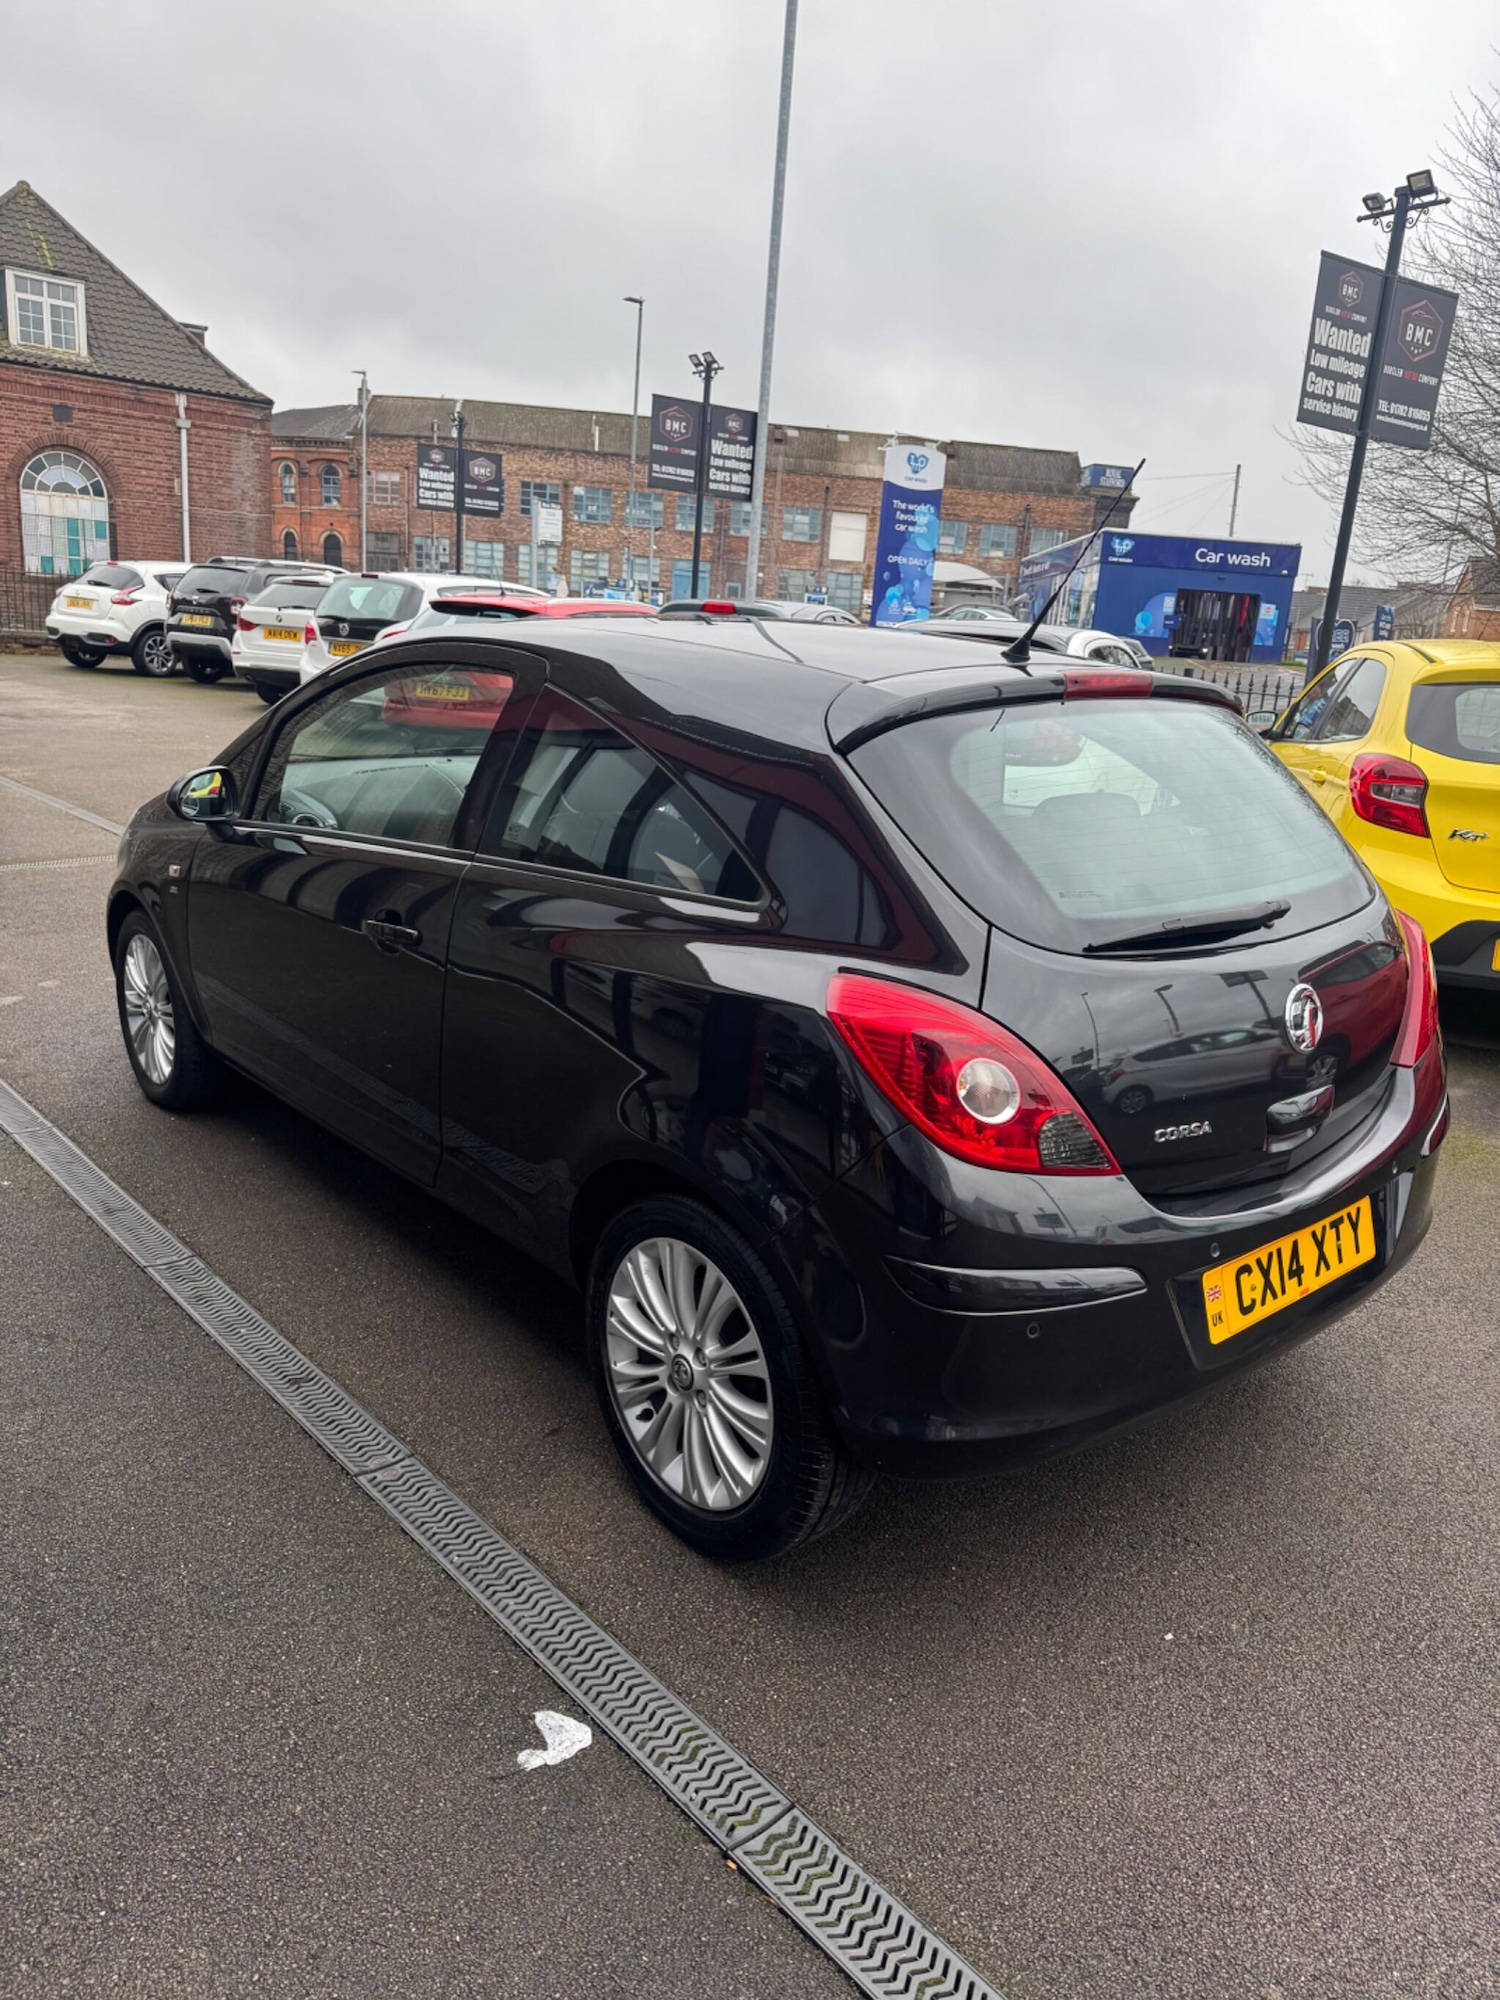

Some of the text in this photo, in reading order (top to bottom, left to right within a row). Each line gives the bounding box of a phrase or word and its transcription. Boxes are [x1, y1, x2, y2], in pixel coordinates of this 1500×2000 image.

[1342, 283, 1359, 299] BMC
[1314, 317, 1372, 357] Wanted
[1405, 323, 1434, 346] BMC
[1310, 349, 1366, 379] Low mileage
[1306, 371, 1362, 405] Cars with
[1303, 397, 1360, 422] service history
[665, 419, 687, 433] BMC
[711, 438, 754, 460] Wanted
[710, 456, 752, 472] Low mileage
[418, 467, 455, 483] Wanted
[709, 468, 731, 483] Cars
[731, 472, 751, 486] with
[419, 488, 437, 499] Cars
[708, 481, 751, 496] service history
[892, 499, 935, 514] The world's
[894, 523, 928, 534] car wash
[887, 554, 929, 567] OPEN DAILY
[1195, 547, 1271, 567] Car wash
[1154, 1120, 1213, 1142] CORSA
[1235, 1206, 1361, 1316] CX14 XTY
[1211, 1310, 1224, 1328] UK
